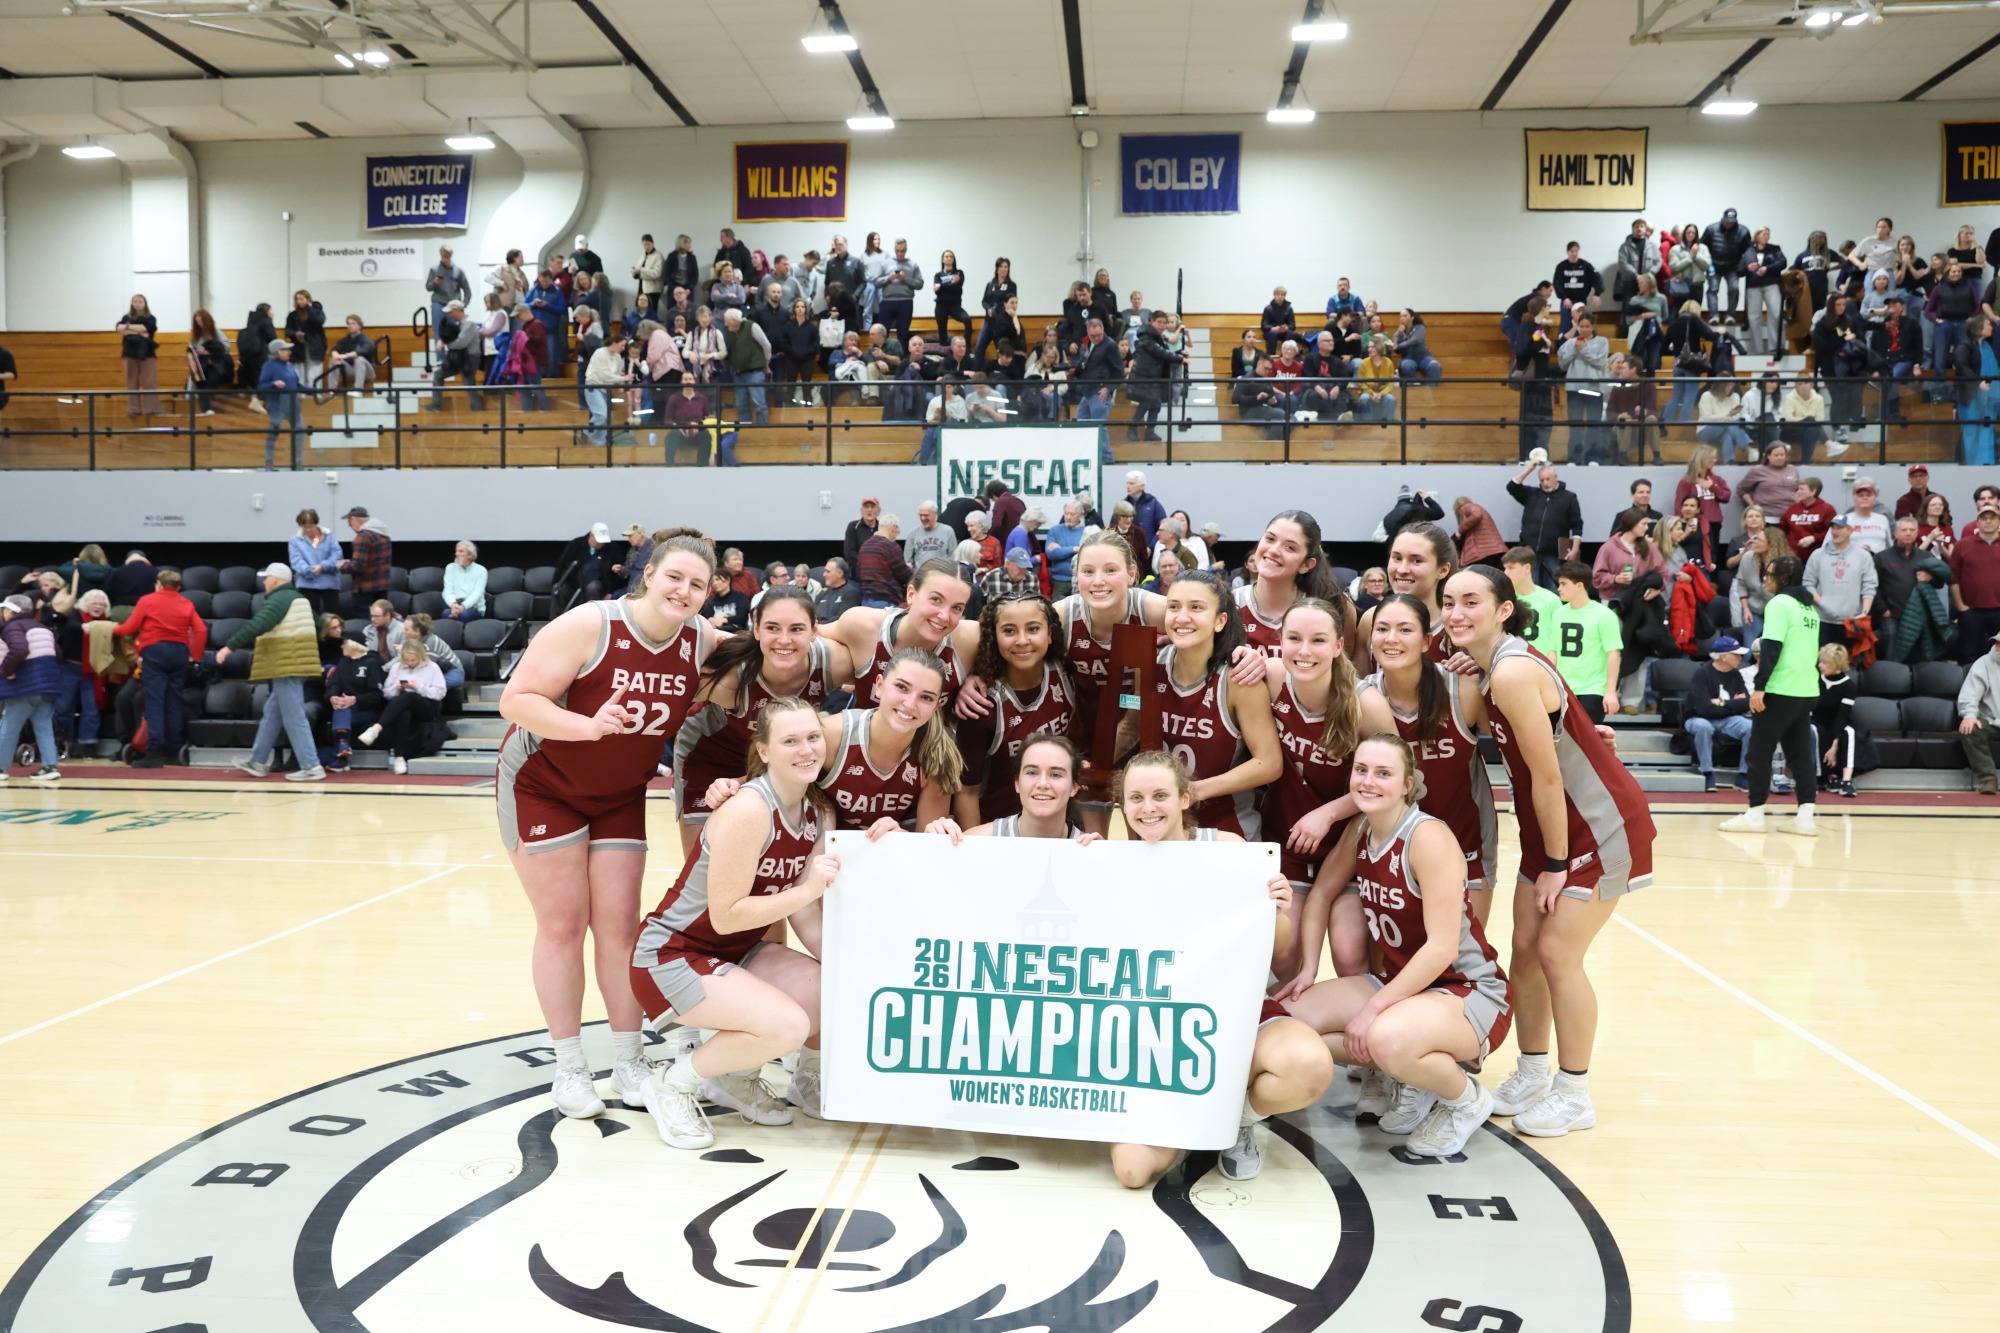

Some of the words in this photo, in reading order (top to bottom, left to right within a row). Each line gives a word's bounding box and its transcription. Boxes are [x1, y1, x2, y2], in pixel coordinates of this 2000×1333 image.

[372, 164, 464, 187] CONNECTICUT
[747, 165, 837, 198] WILLIAMS
[1135, 157, 1225, 190] COLBY
[1540, 154, 1634, 186] HAMILTON
[383, 194, 448, 217] COLLEGE
[319, 248, 365, 256] Bowdoin
[367, 246, 415, 255] Students
[948, 459, 1091, 497] NESCAC
[916, 536, 945, 551] BATES
[1560, 622, 1584, 657] B
[610, 667, 687, 697] BATES
[622, 699, 671, 736] 32
[835, 788, 914, 814] BATES
[756, 855, 806, 879] BATE
[915, 938, 951, 963] 20
[913, 962, 950, 988] 26
[971, 941, 1175, 1001] NESCAC
[869, 990, 1214, 1092] CHAMPIONS
[950, 1079, 1025, 1107] WOMEN'S
[1029, 1083, 1128, 1114] BASKETBALL
